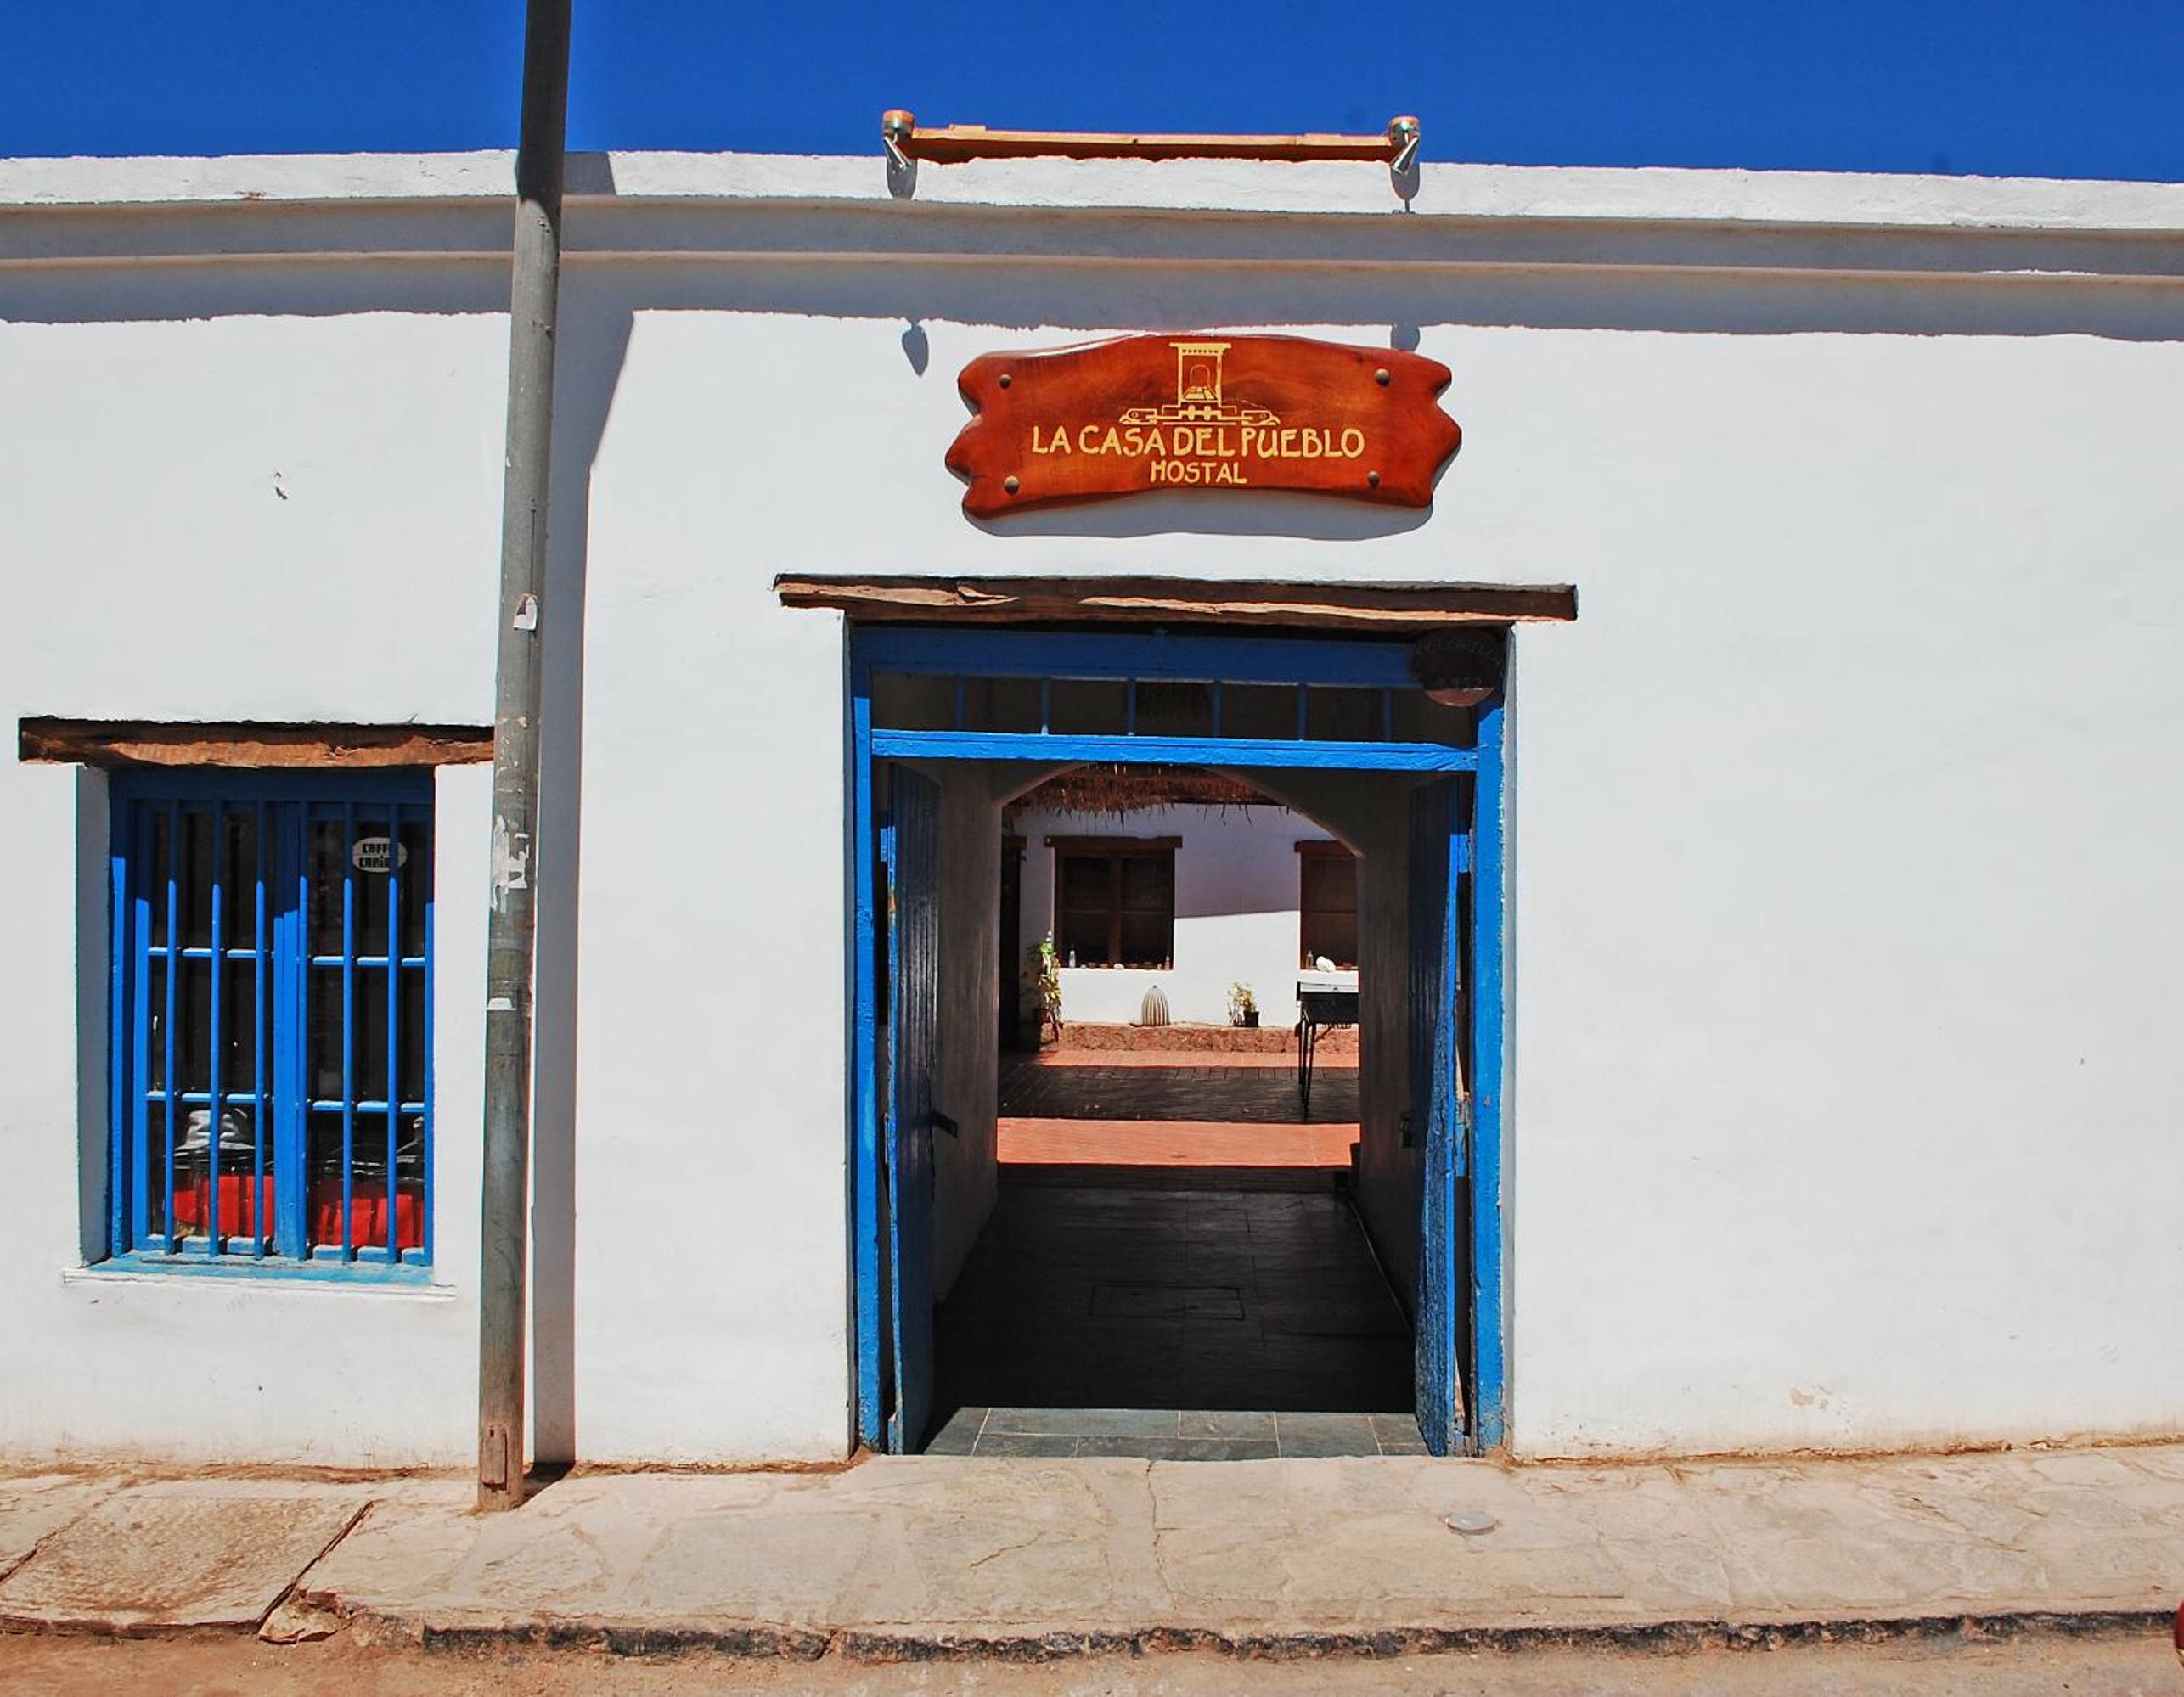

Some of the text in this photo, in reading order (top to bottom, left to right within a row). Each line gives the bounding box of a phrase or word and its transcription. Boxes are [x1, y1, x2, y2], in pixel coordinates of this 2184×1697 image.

[1031, 424, 1365, 459] LA CASA DEL PUEBLO
[1149, 459, 1248, 485] HOSTAL
[362, 842, 395, 854] CAFF
